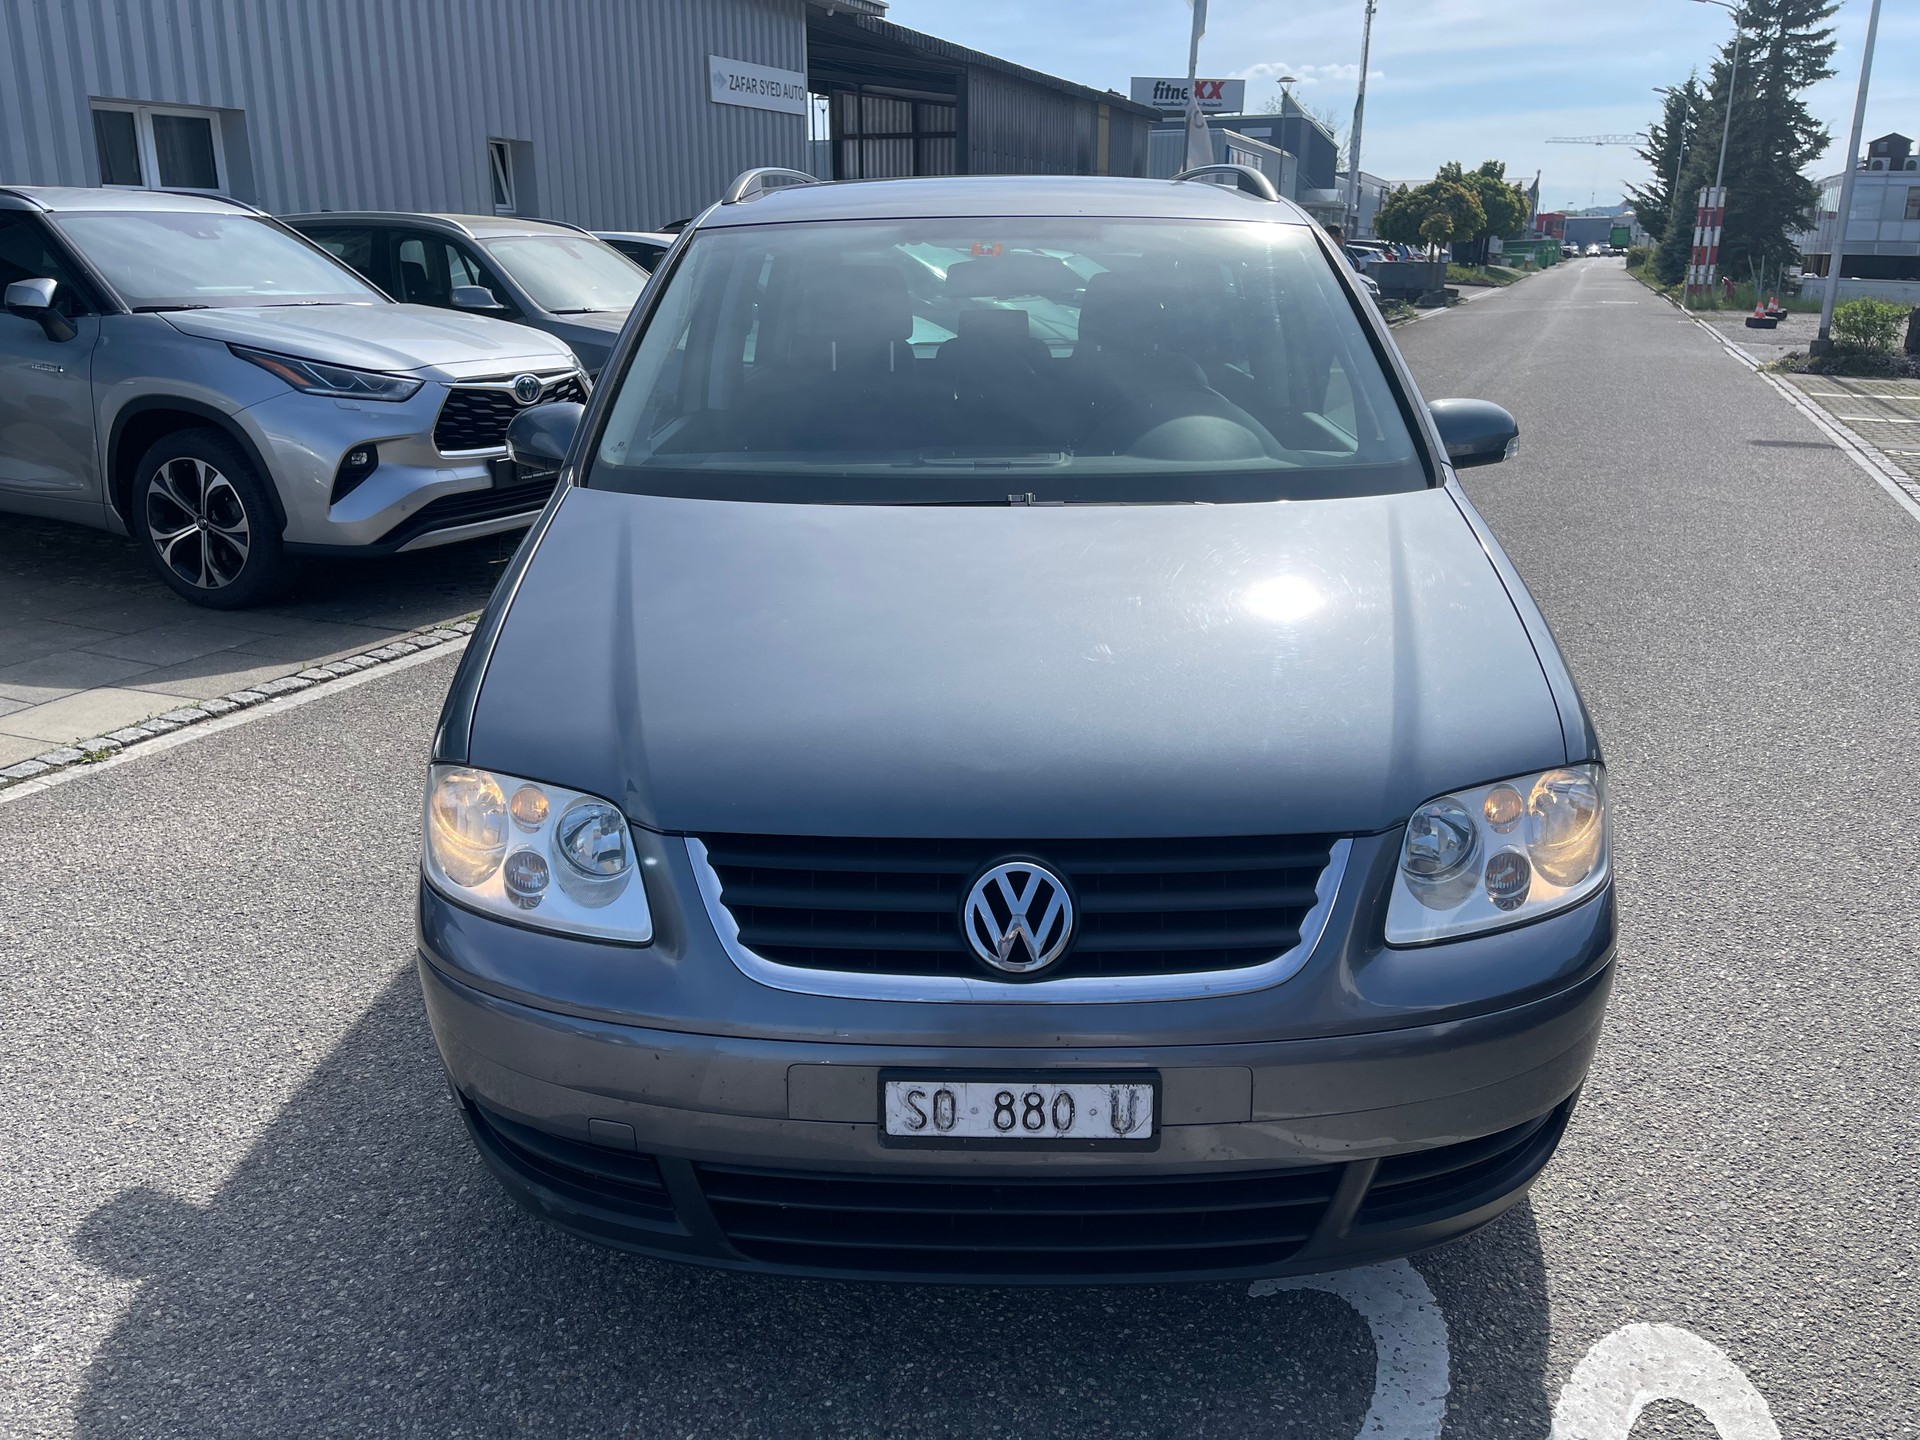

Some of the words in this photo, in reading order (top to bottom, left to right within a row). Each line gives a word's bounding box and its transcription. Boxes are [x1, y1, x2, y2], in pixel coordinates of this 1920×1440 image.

[729, 74, 758, 94] ZAFAR
[760, 79, 782, 97] SYED
[783, 83, 804, 101] AUTO
[907, 1089, 956, 1132] SO
[993, 1090, 1076, 1132] 880
[1110, 1088, 1137, 1134] U
